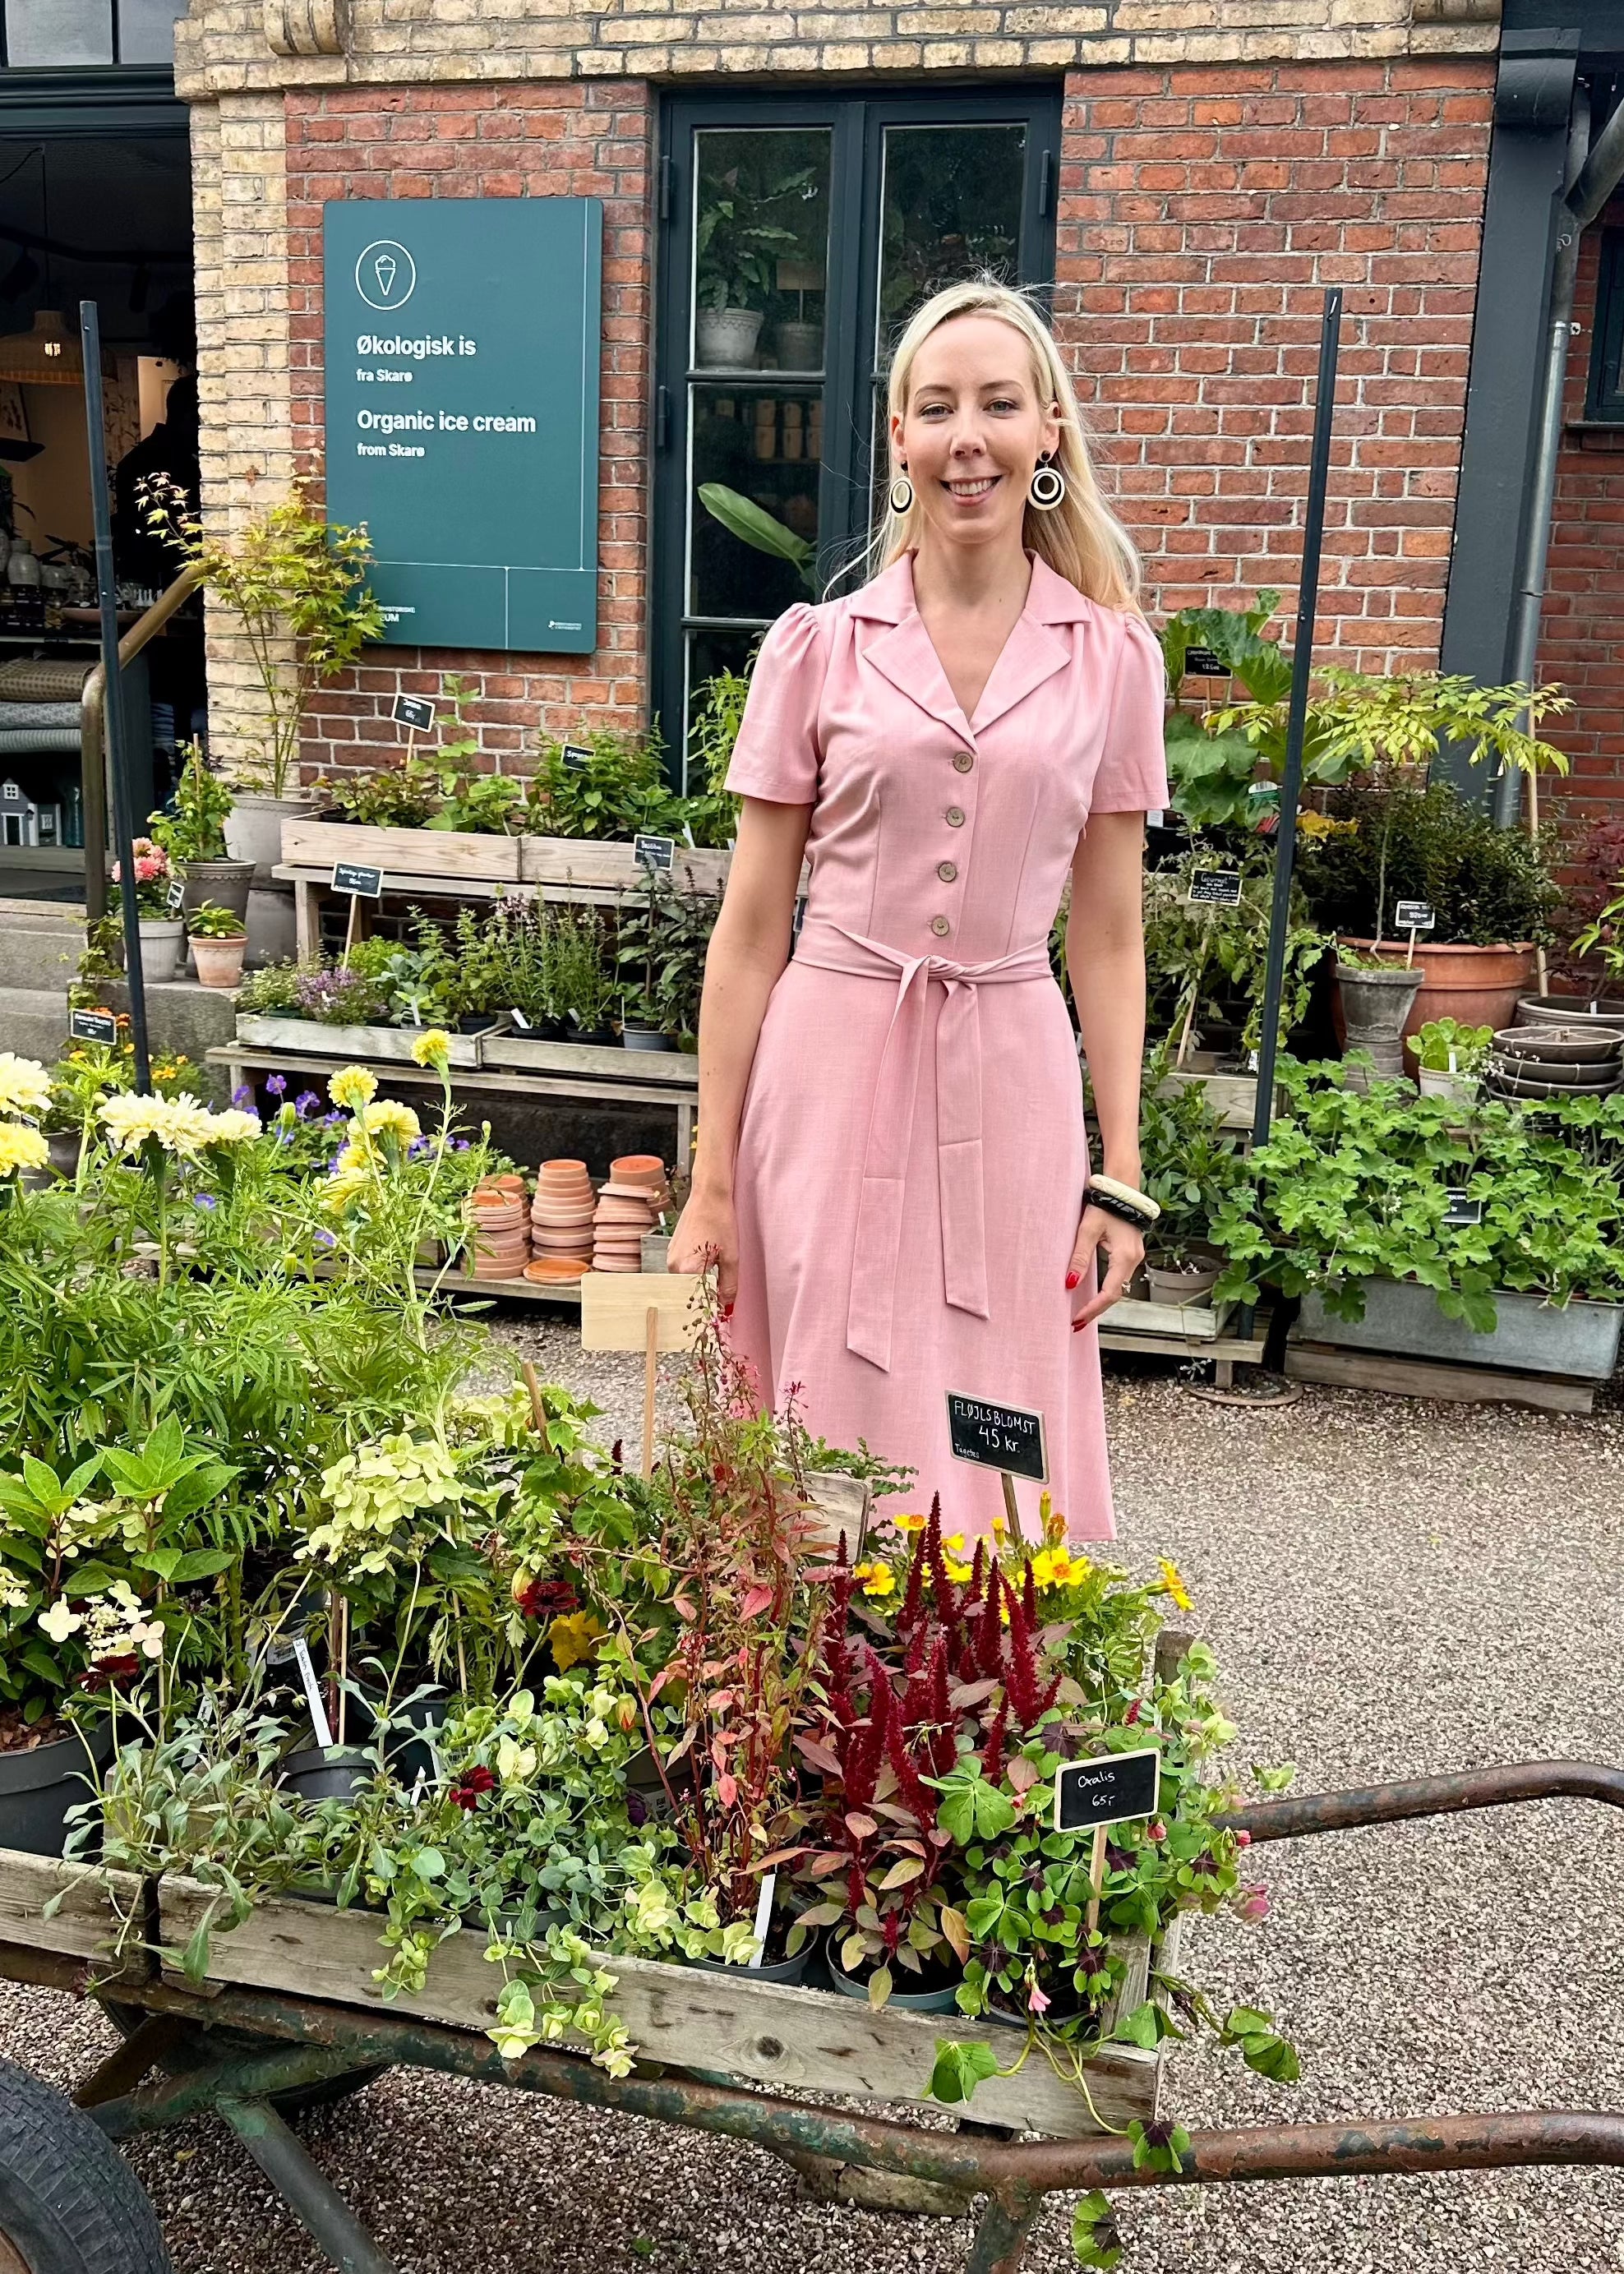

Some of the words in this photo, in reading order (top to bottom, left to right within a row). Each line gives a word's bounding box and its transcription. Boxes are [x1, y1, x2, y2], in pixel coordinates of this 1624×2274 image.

[356, 334, 455, 360] Økologisk
[459, 334, 478, 356] is
[356, 368, 375, 382] fra
[357, 409, 435, 435] Organic
[439, 410, 469, 431] ice
[473, 415, 537, 433] cream
[357, 443, 387, 456] from
[978, 1424, 1001, 1448] 45
[1077, 1770, 1116, 1788] Oxalis
